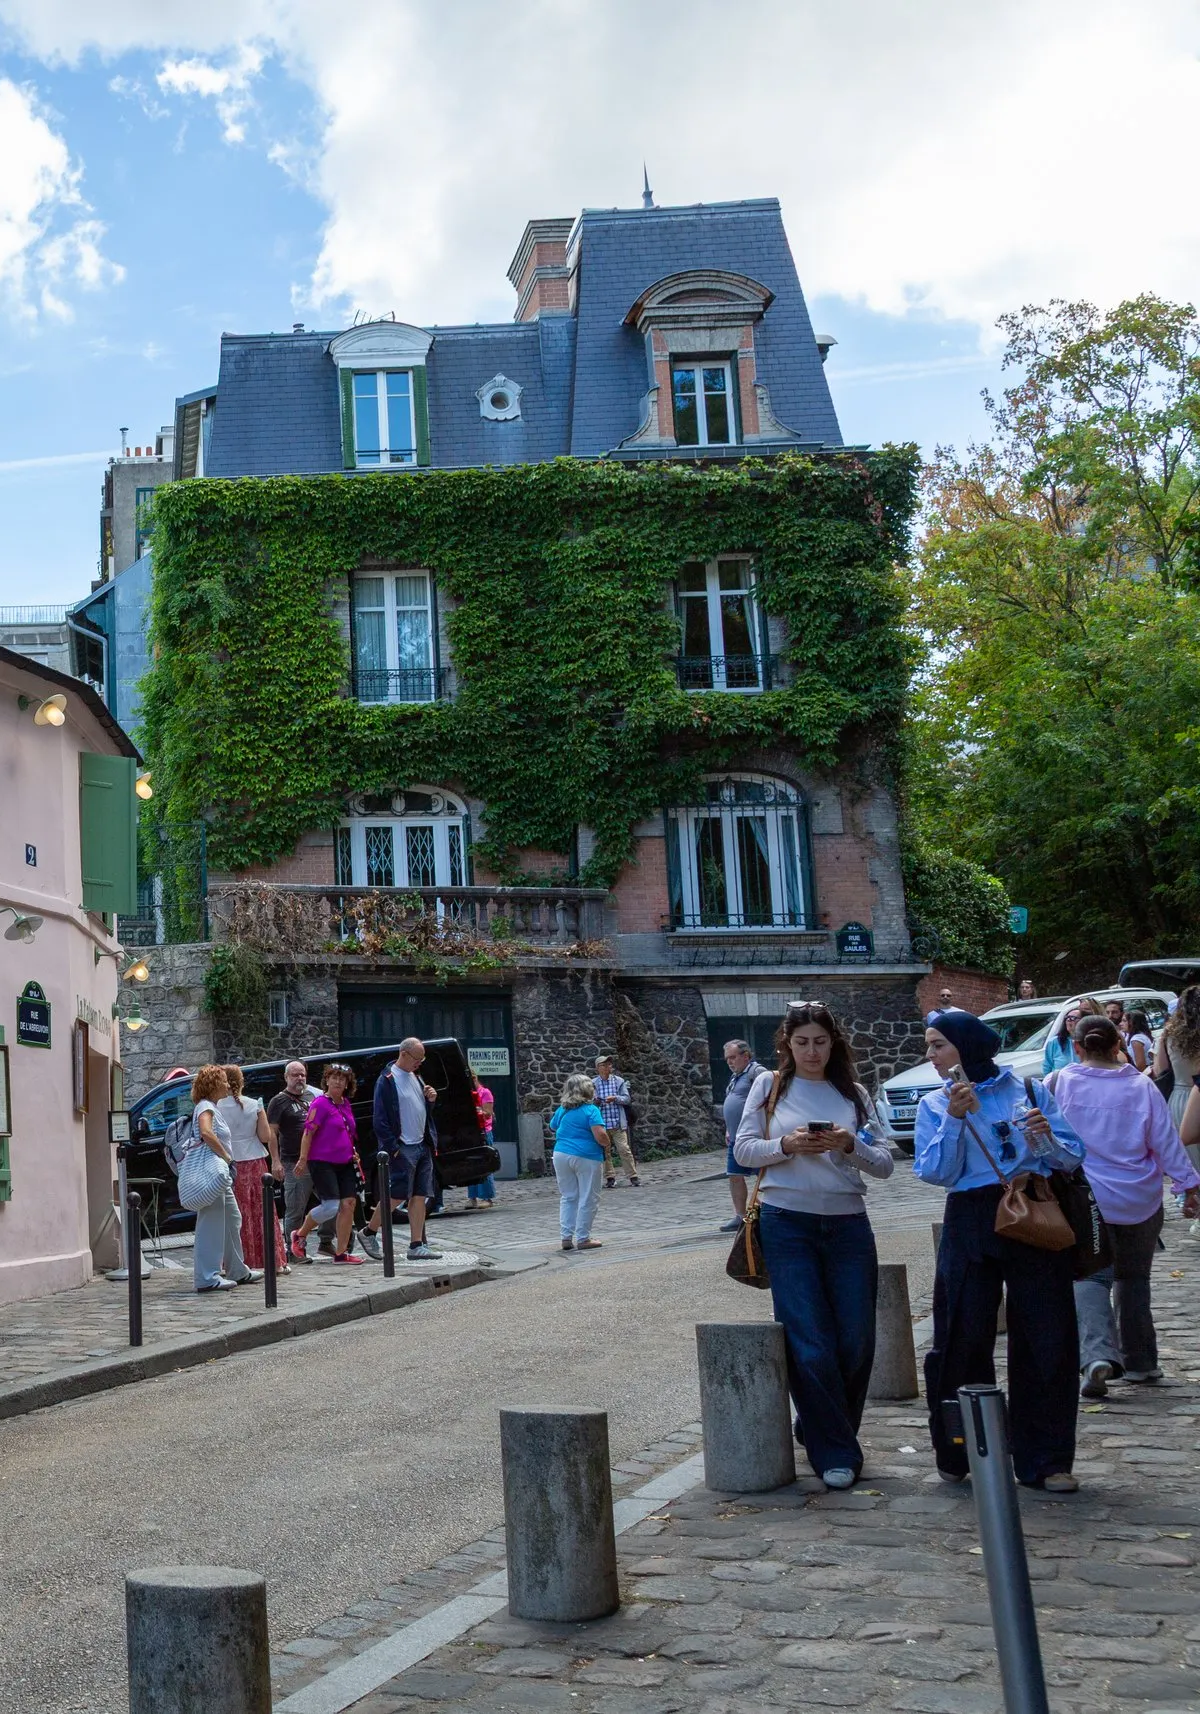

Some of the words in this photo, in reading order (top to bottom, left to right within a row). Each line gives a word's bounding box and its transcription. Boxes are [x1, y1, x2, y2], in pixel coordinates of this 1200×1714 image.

[28, 846, 34, 865] 2
[30, 1010, 39, 1020] RUE
[20, 1021, 26, 1031] DE
[469, 1050, 491, 1061] PARKING
[1090, 1203, 1101, 1255] lululemon
